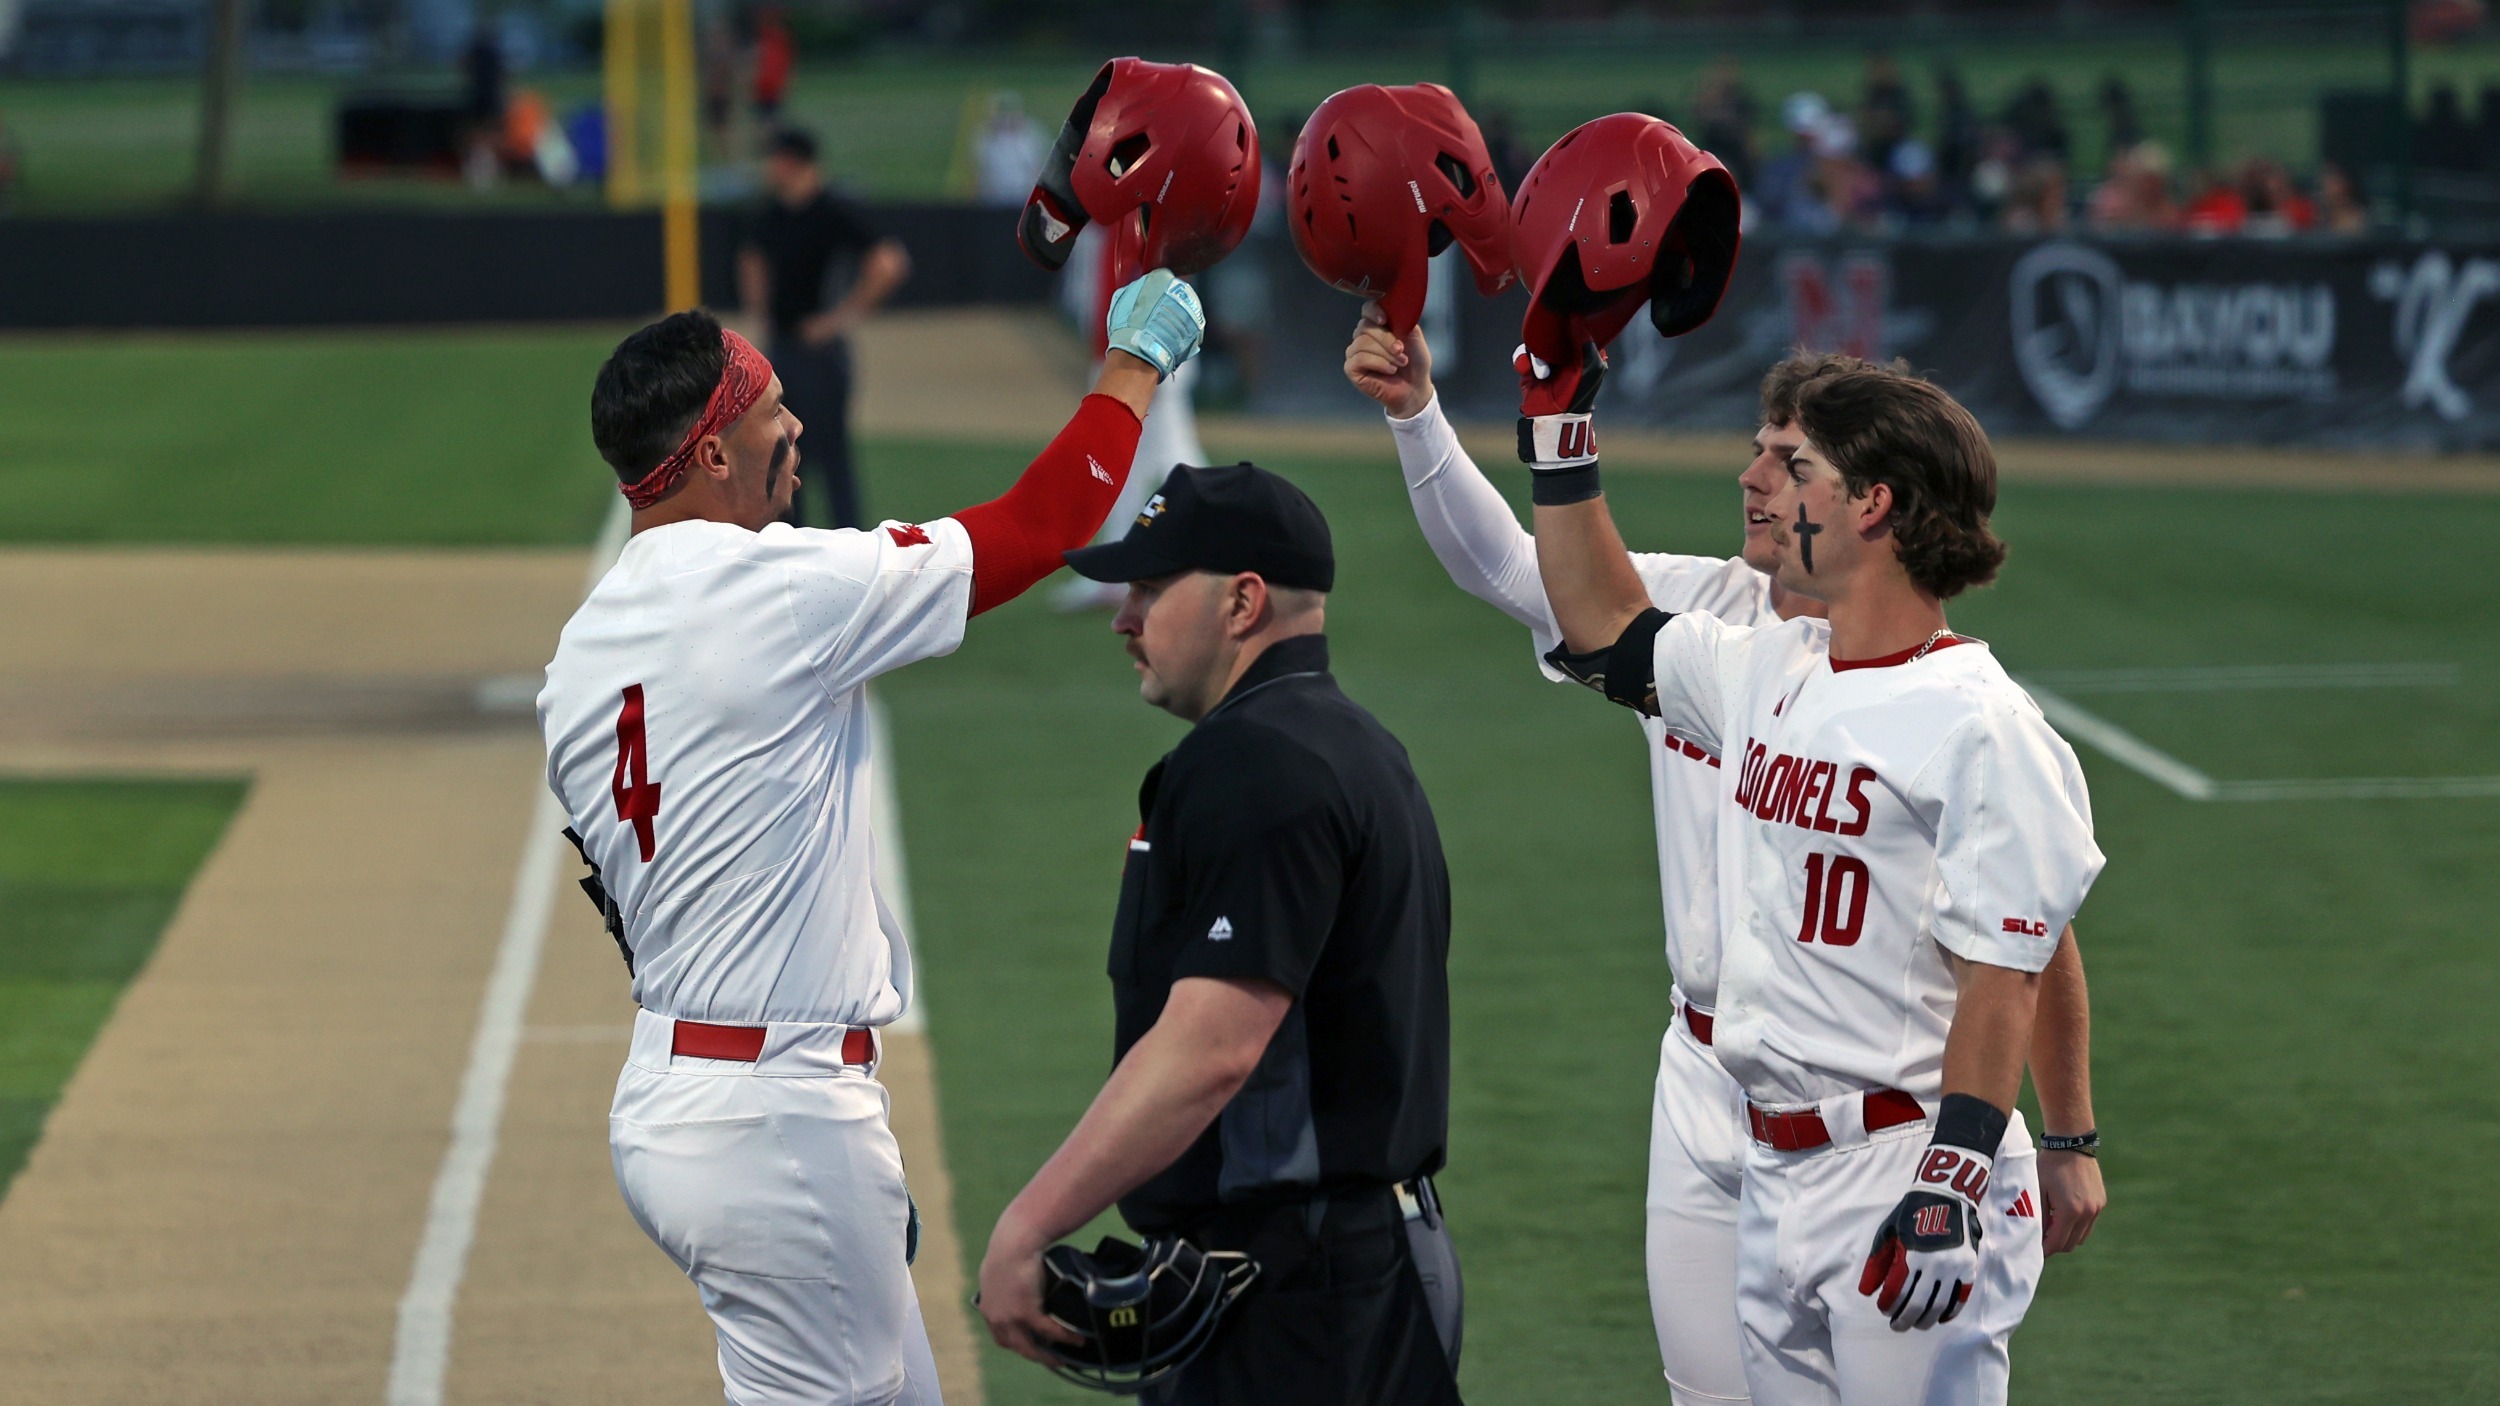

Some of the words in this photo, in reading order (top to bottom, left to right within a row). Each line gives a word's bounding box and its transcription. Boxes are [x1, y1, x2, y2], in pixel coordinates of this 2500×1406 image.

[1407, 180, 1427, 213] marucci
[2122, 283, 2336, 364] BAYOU
[1086, 453, 1114, 486] adidas
[612, 683, 661, 863] 4
[1797, 852, 1870, 947] 10
[2050, 1140, 2065, 1149] EVEN
